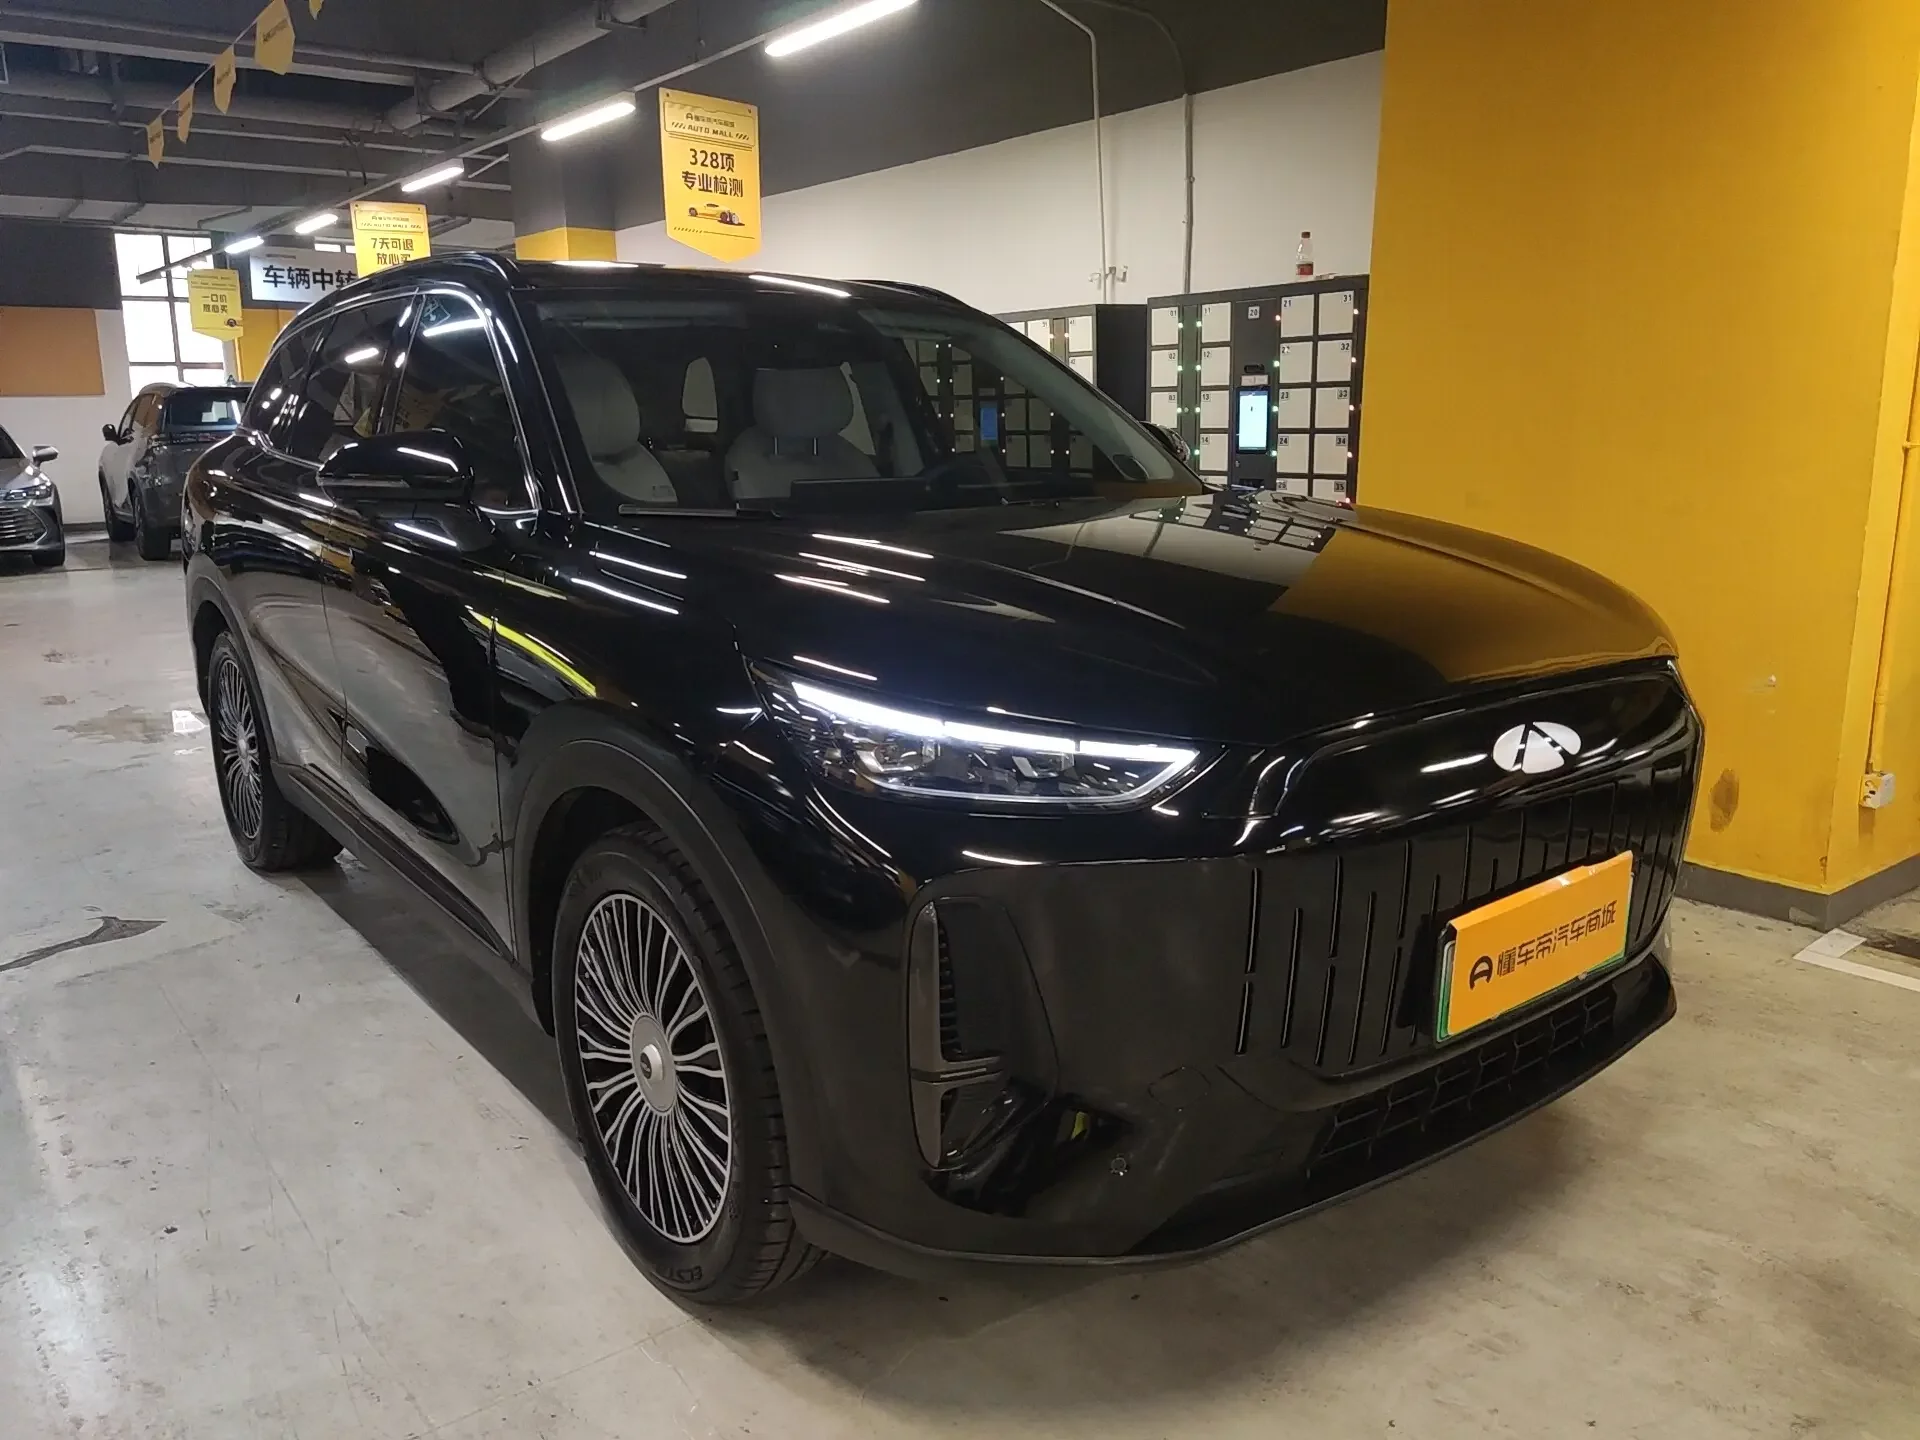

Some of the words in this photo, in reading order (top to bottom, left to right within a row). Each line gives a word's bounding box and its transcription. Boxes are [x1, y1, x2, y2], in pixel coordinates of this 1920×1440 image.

[687, 124, 710, 134] AUTO
[712, 129, 734, 138] MALL
[689, 148, 735, 173] 328项
[681, 171, 744, 197] 专业检测
[371, 237, 414, 251] 7天可退
[1343, 294, 1352, 302] 31
[1283, 299, 1291, 307] 21
[1341, 343, 1350, 351] 32
[1280, 391, 1289, 399] 23
[1279, 437, 1288, 445] 24
[1337, 437, 1346, 445] 34
